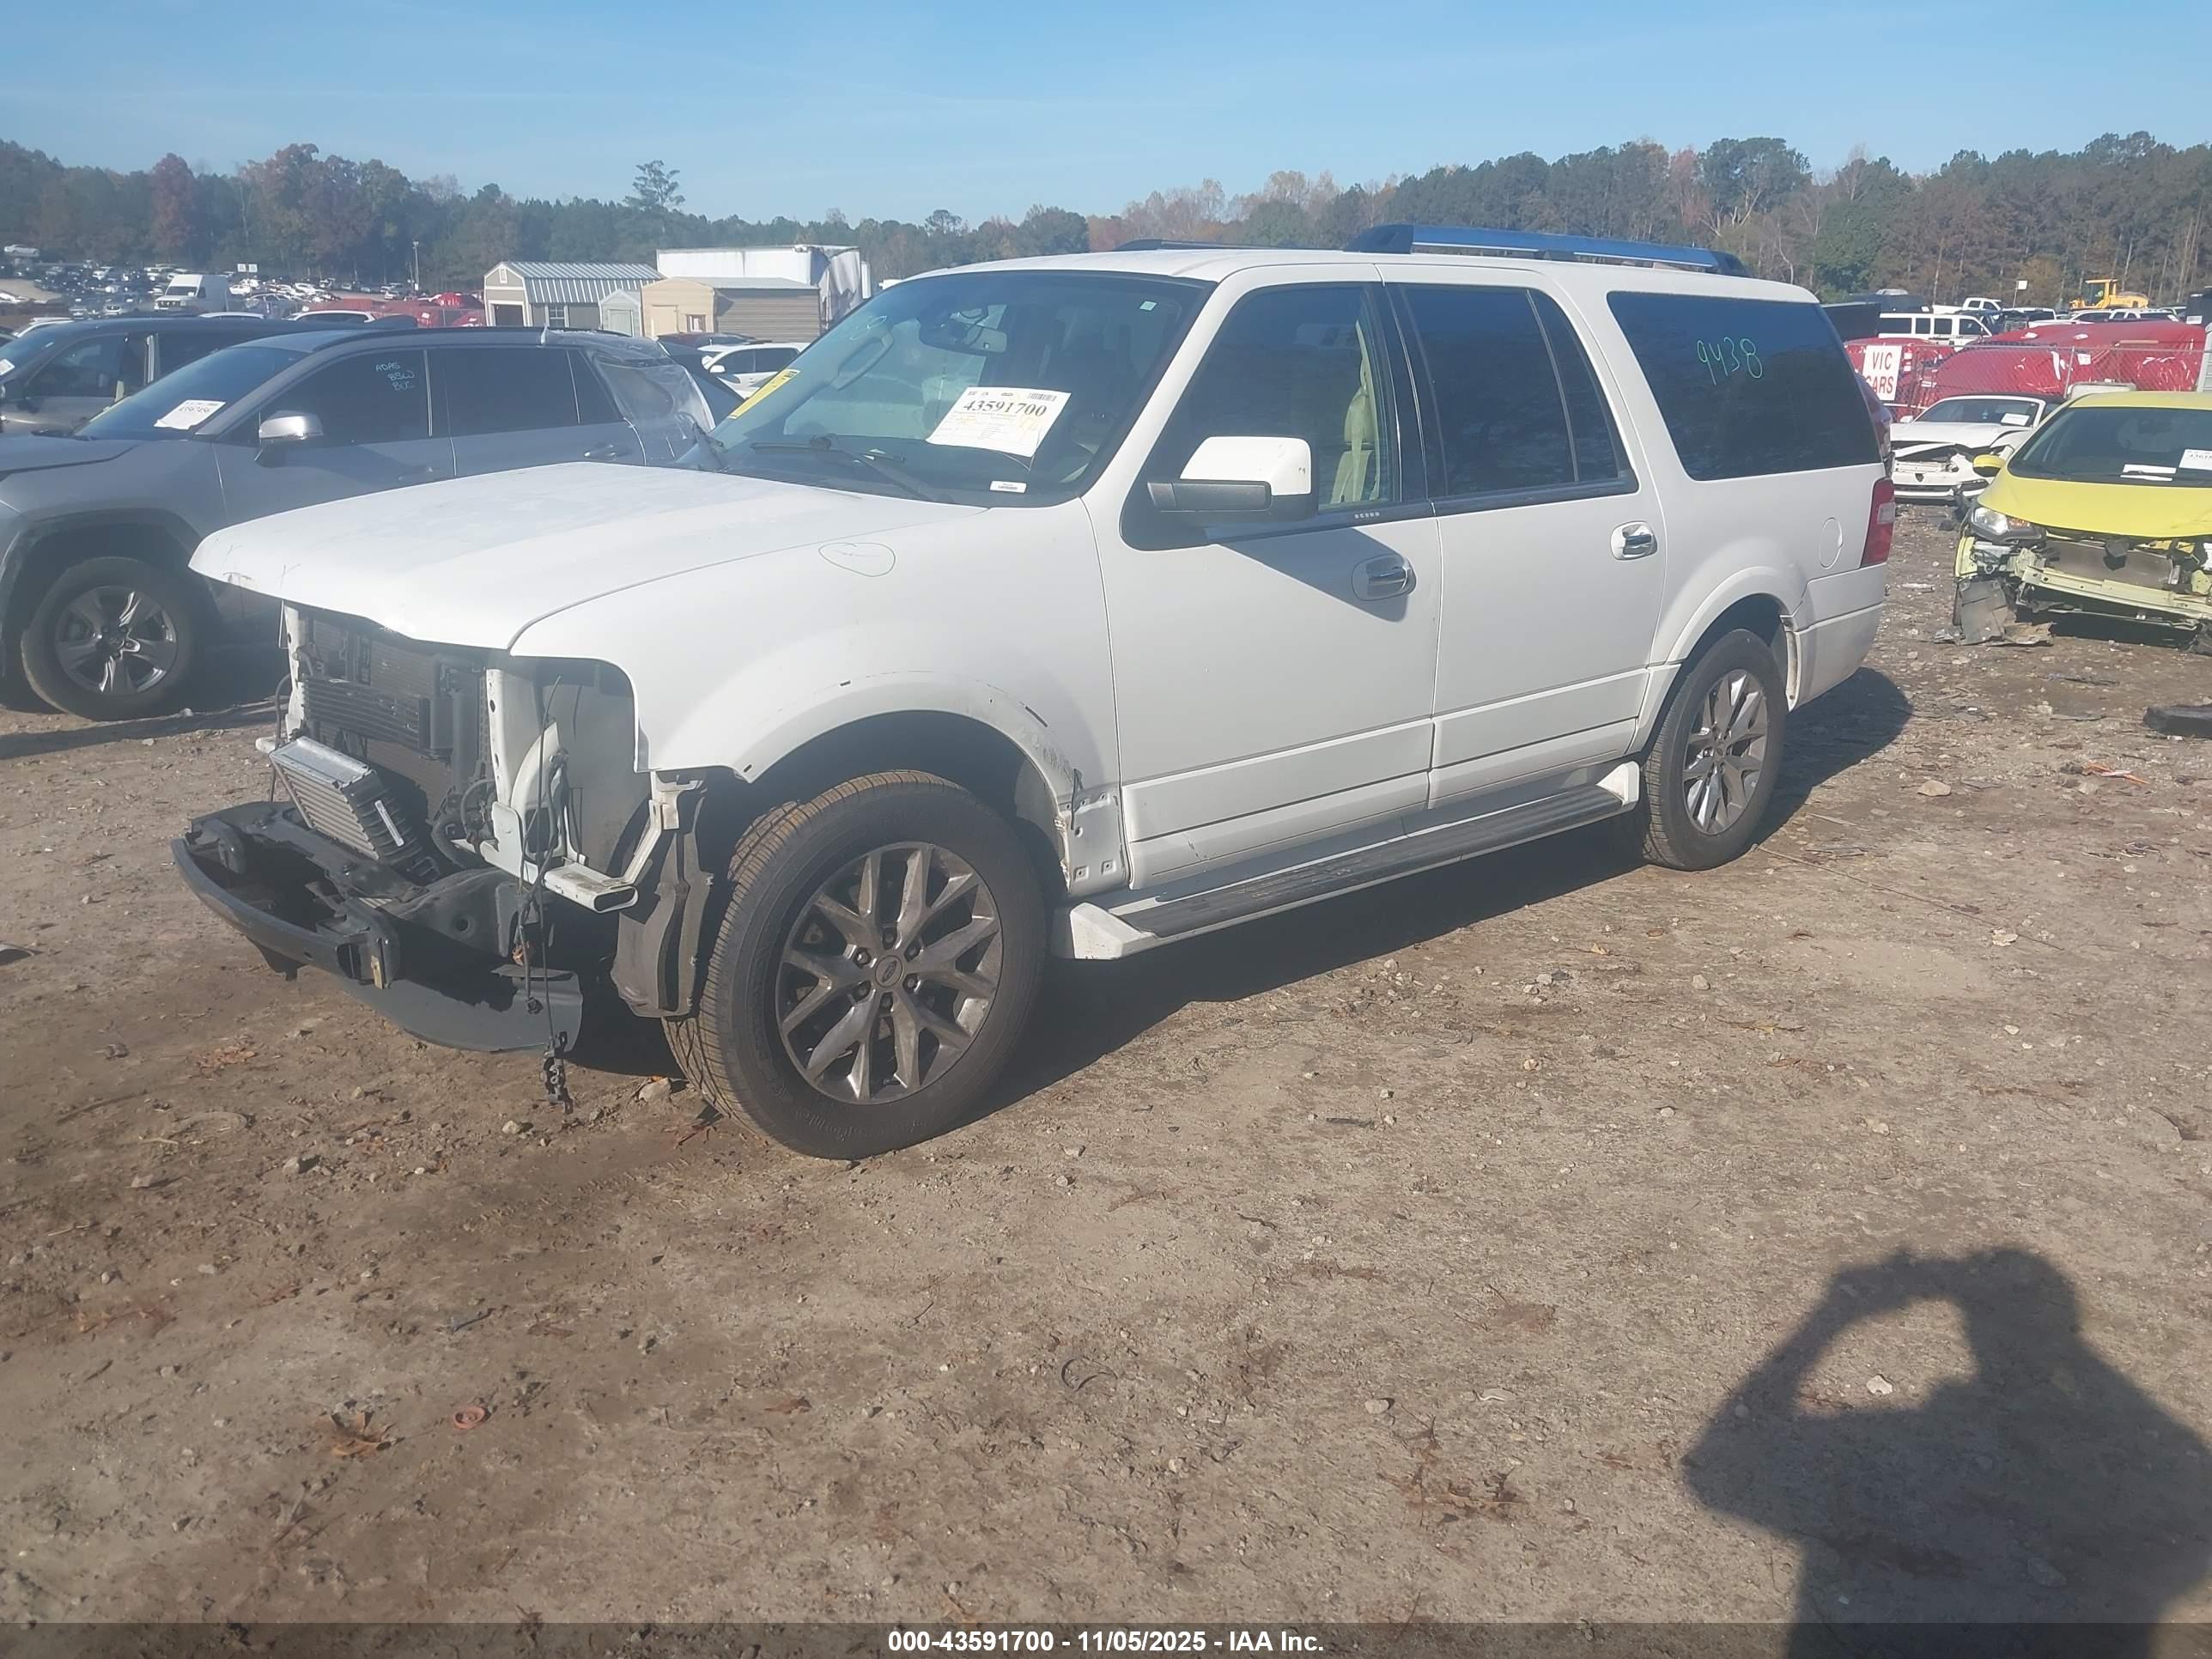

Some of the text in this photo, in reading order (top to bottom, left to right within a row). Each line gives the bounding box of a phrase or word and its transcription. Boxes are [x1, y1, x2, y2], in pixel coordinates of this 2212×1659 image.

[1697, 337, 1762, 385] 9438
[1873, 351, 1893, 370] VIC
[963, 399, 1048, 417] 43591700
